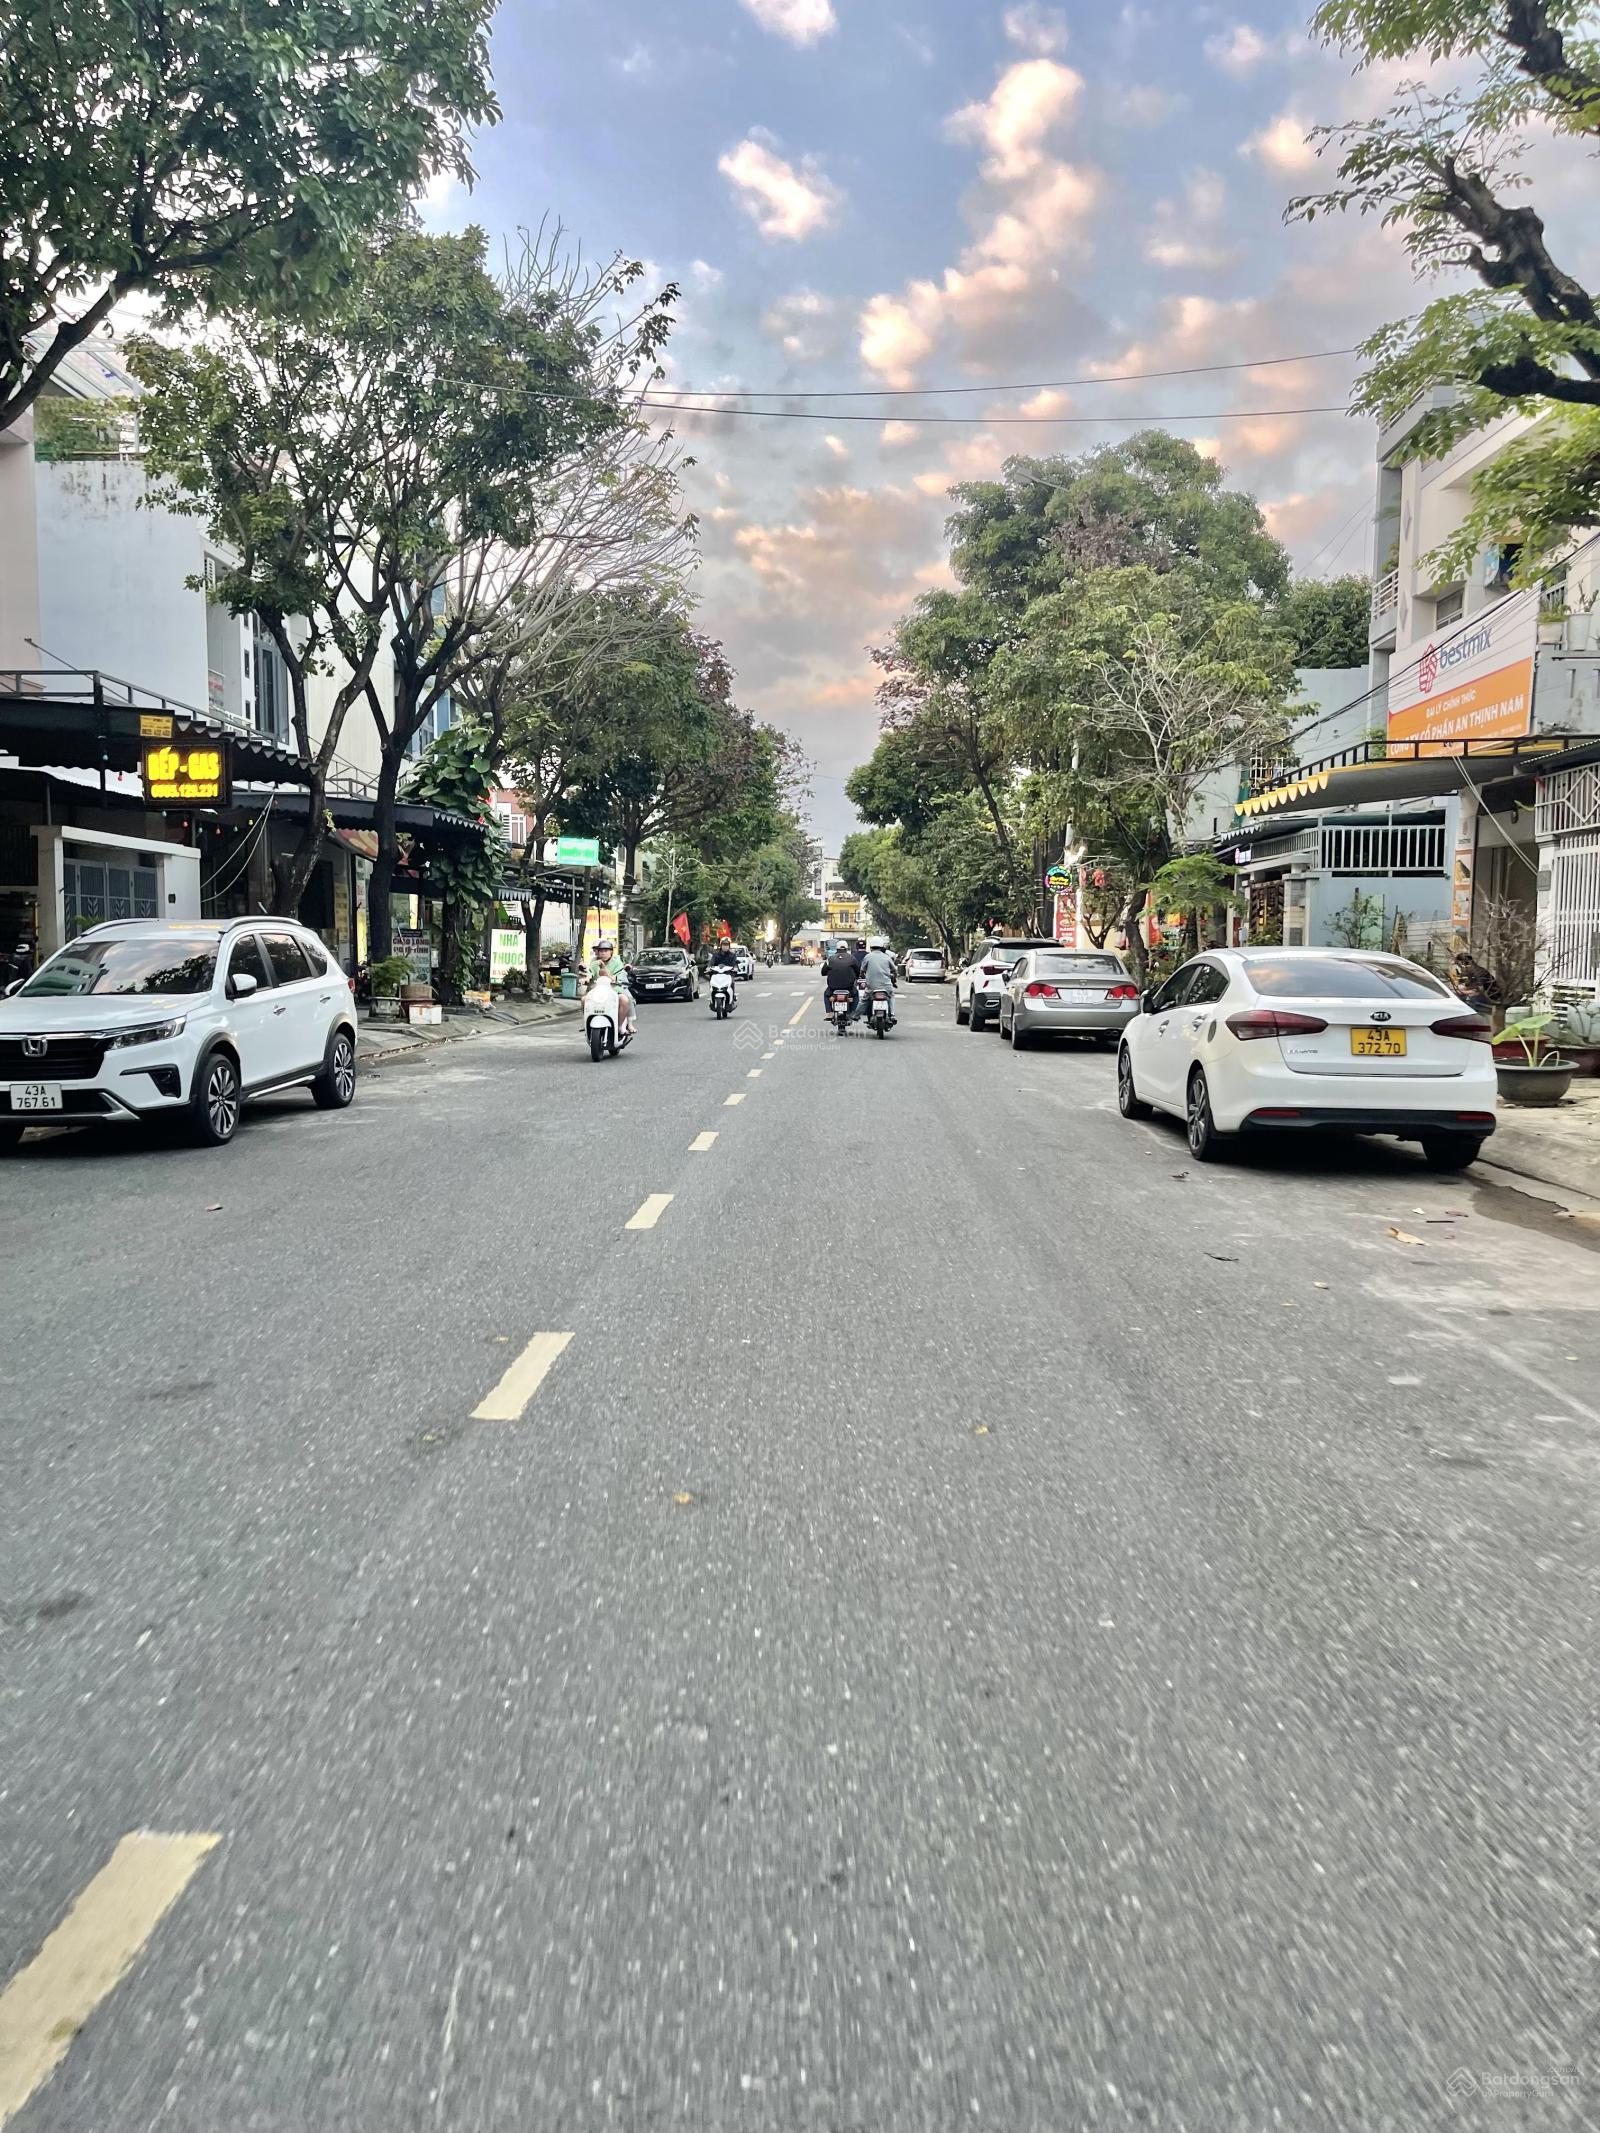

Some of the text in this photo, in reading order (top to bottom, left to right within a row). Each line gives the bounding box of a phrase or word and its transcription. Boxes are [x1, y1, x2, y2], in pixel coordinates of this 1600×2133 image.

[1440, 627, 1492, 669] bestmix
[1454, 715, 1468, 733] AN
[1469, 705, 1498, 728] THỊNH
[1499, 694, 1525, 716] NAM
[188, 752, 220, 780] GAS
[1373, 1012, 1389, 1020] KIA
[1368, 1030, 1390, 1042] 43A
[1358, 1043, 1401, 1054] 372.70
[25, 1085, 47, 1095] 43A
